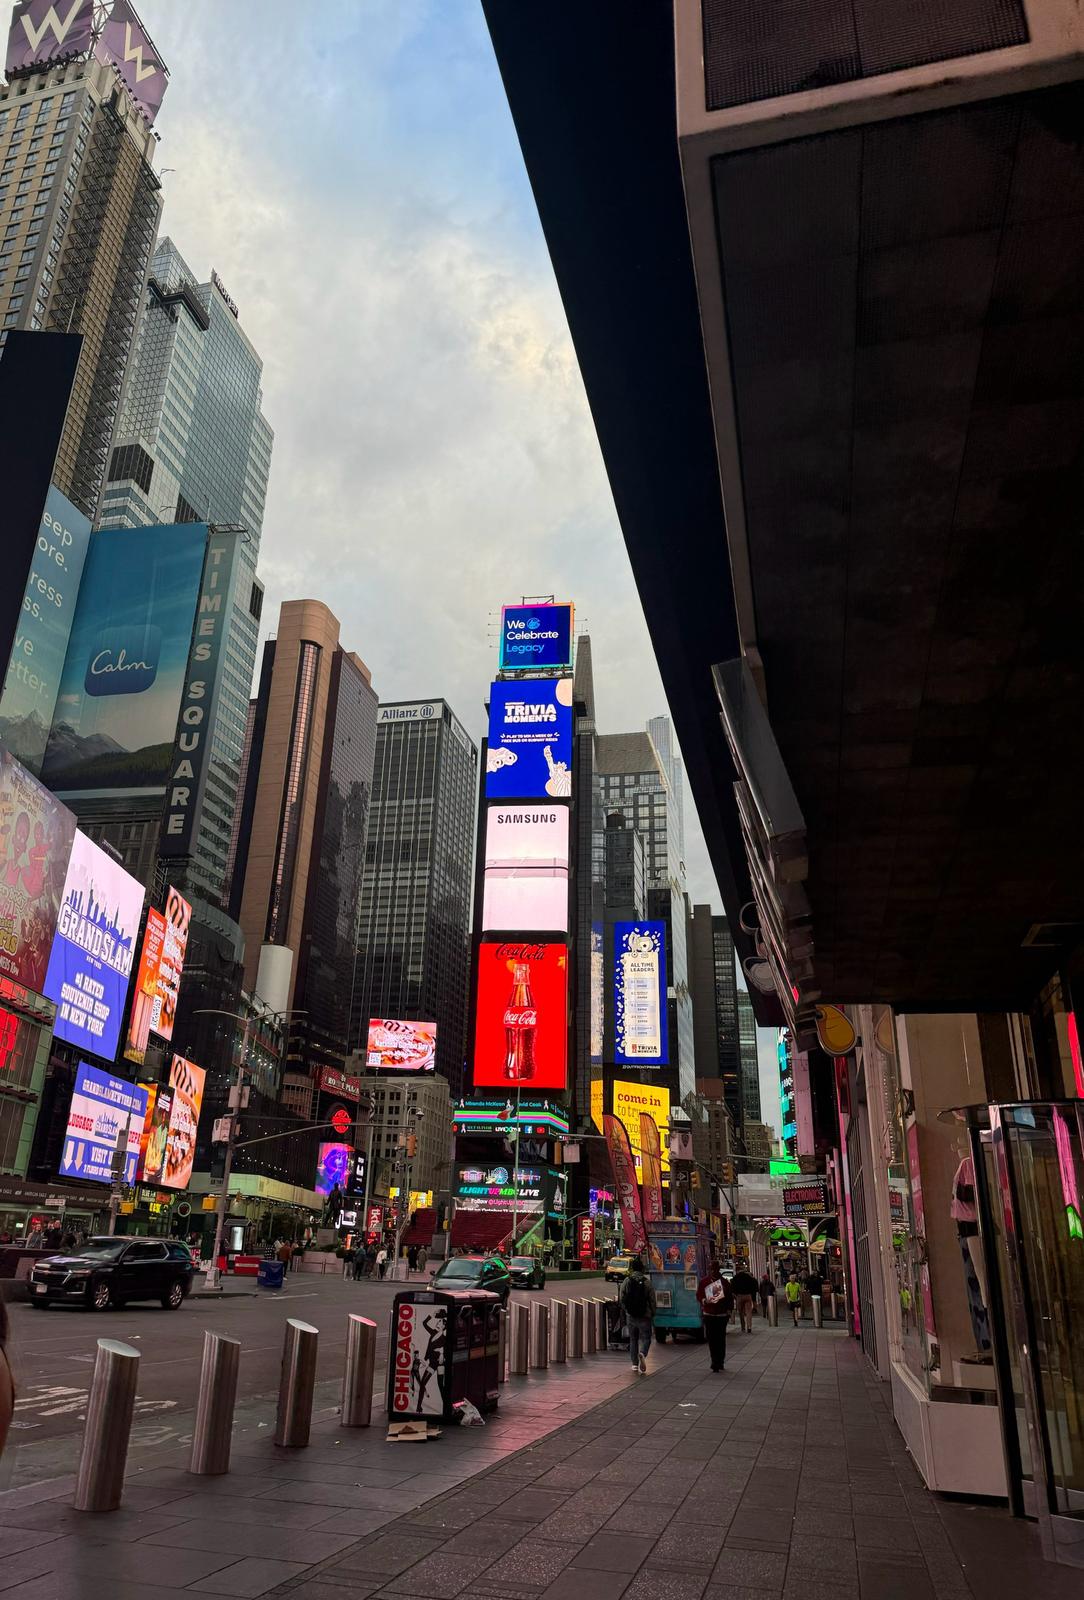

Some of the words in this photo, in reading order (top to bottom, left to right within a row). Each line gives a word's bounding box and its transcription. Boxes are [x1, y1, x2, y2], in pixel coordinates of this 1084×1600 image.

[20, 0, 83, 53] W
[43, 511, 73, 546] eep
[37, 536, 68, 572] ore.
[30, 570, 62, 608] ress
[194, 548, 226, 661] TIMES
[506, 620, 526, 630] We
[506, 630, 560, 640] Celebrate
[506, 644, 545, 654] Legacy
[91, 649, 153, 675] Calm
[381, 708, 418, 720] Allianz
[504, 704, 557, 716] TRIVIA
[504, 714, 557, 724] MOMENTS
[166, 680, 206, 835] SQUARE
[496, 813, 558, 824] SAMSUNG
[84, 974, 105, 1000] RATED
[60, 982, 94, 1014] SOUVENIR
[94, 1001, 110, 1021] SHOP
[60, 1002, 70, 1020] IN
[70, 1006, 86, 1029] NEW
[87, 1014, 105, 1038] YORK
[503, 1008, 538, 1025] Coca-Cola
[618, 1093, 648, 1104] come
[650, 1094, 661, 1106] in
[618, 1104, 626, 1116] to
[628, 1105, 641, 1122] try
[91, 1146, 108, 1164] VISIT
[520, 1187, 540, 1196] LIVE
[784, 1189, 822, 1202] ELECTRONICS
[786, 1204, 803, 1212] CAMERA
[804, 1202, 824, 1210] LUGGAGE
[581, 1218, 593, 1242] tkts
[394, 1304, 414, 1412] CHICAGO
